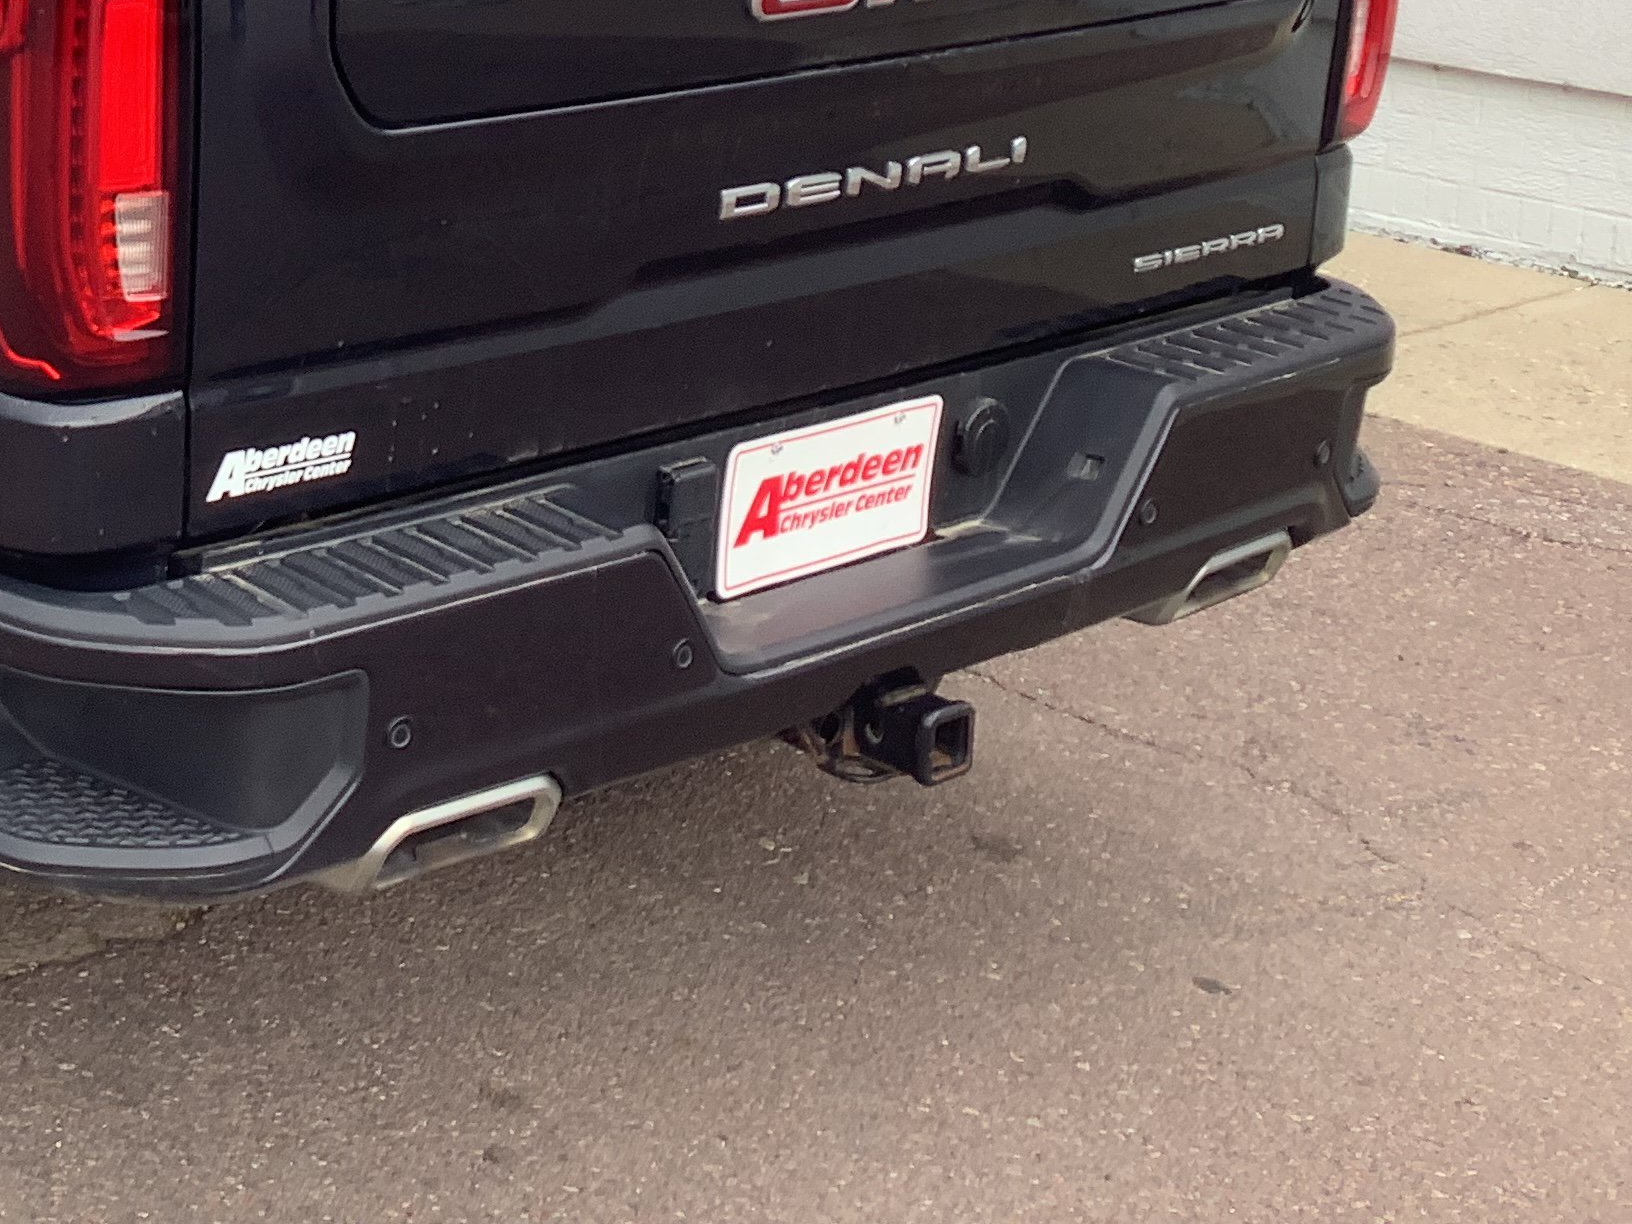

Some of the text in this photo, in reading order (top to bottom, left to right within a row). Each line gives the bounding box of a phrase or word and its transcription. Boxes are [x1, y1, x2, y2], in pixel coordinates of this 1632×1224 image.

[719, 136, 1027, 221] DENALI
[1133, 223, 1285, 273] SIERRA
[206, 431, 356, 503] Aberdeen
[245, 459, 353, 493] Chrysler Center
[733, 443, 924, 549] Aberdeen
[780, 483, 913, 534] Chrysler Center
